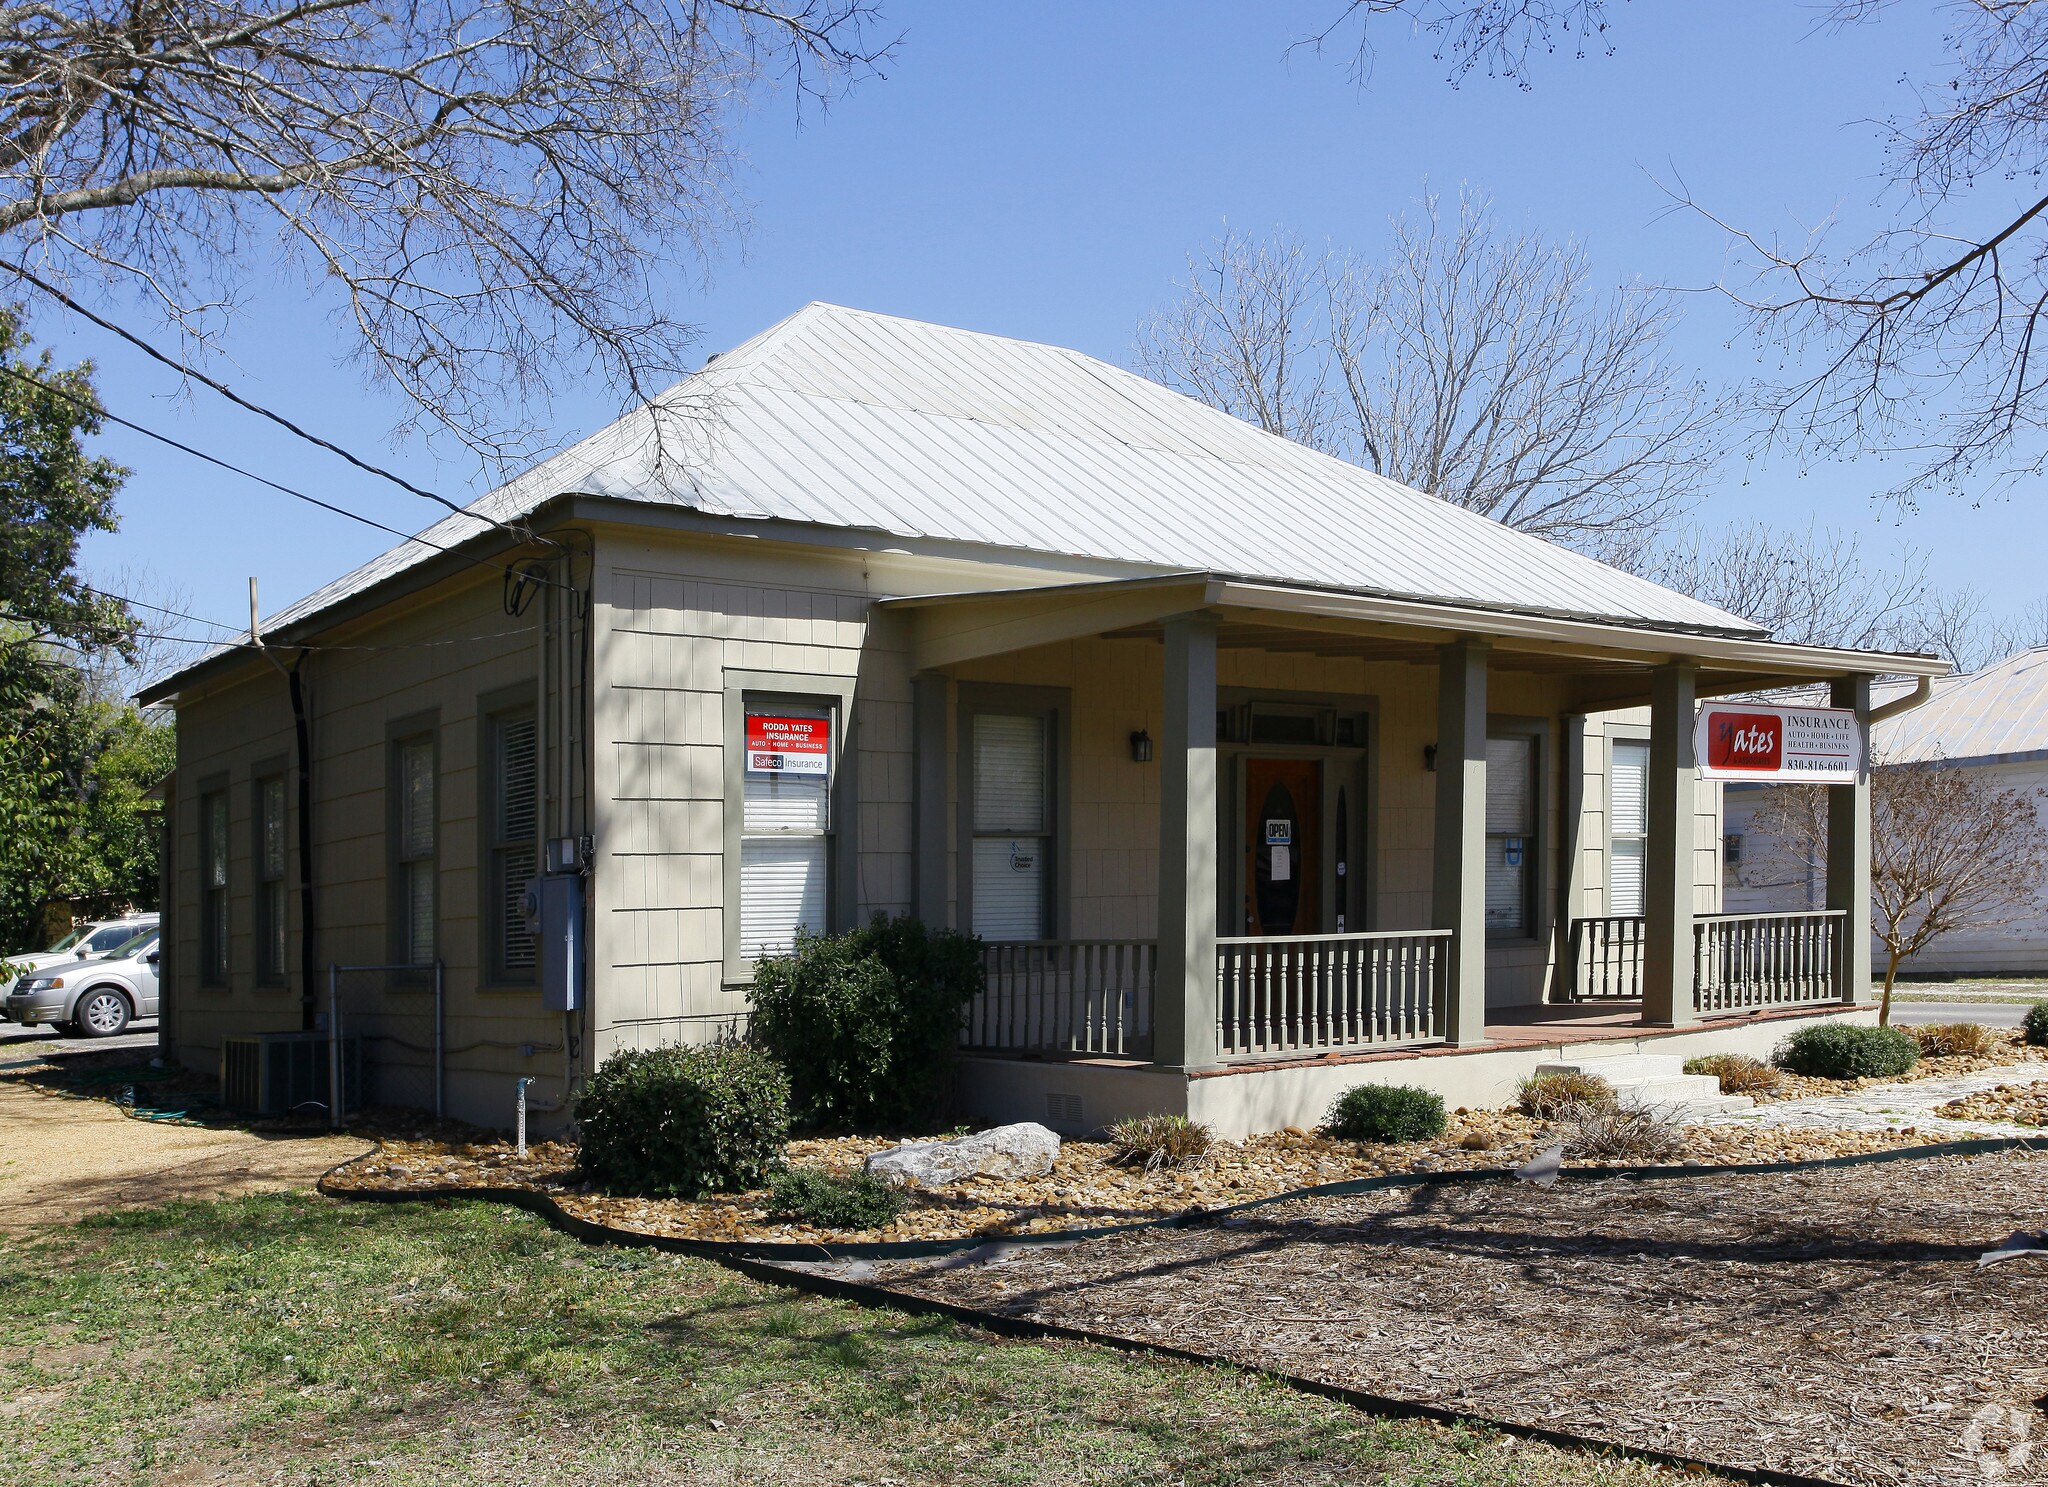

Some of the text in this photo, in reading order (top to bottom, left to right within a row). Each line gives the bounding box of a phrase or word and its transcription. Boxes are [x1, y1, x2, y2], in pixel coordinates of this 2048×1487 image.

[763, 722, 813, 733] RODDA YATES
[1787, 715, 1850, 730] INSURANCE
[766, 732, 809, 741] INSURANCE
[1811, 732, 1830, 740] HOME
[1788, 740, 1814, 748] HEALTH
[755, 756, 823, 769] Safeco Insurance
[1787, 759, 1848, 772] 830-816-6601
[1269, 823, 1289, 837] OPEN
